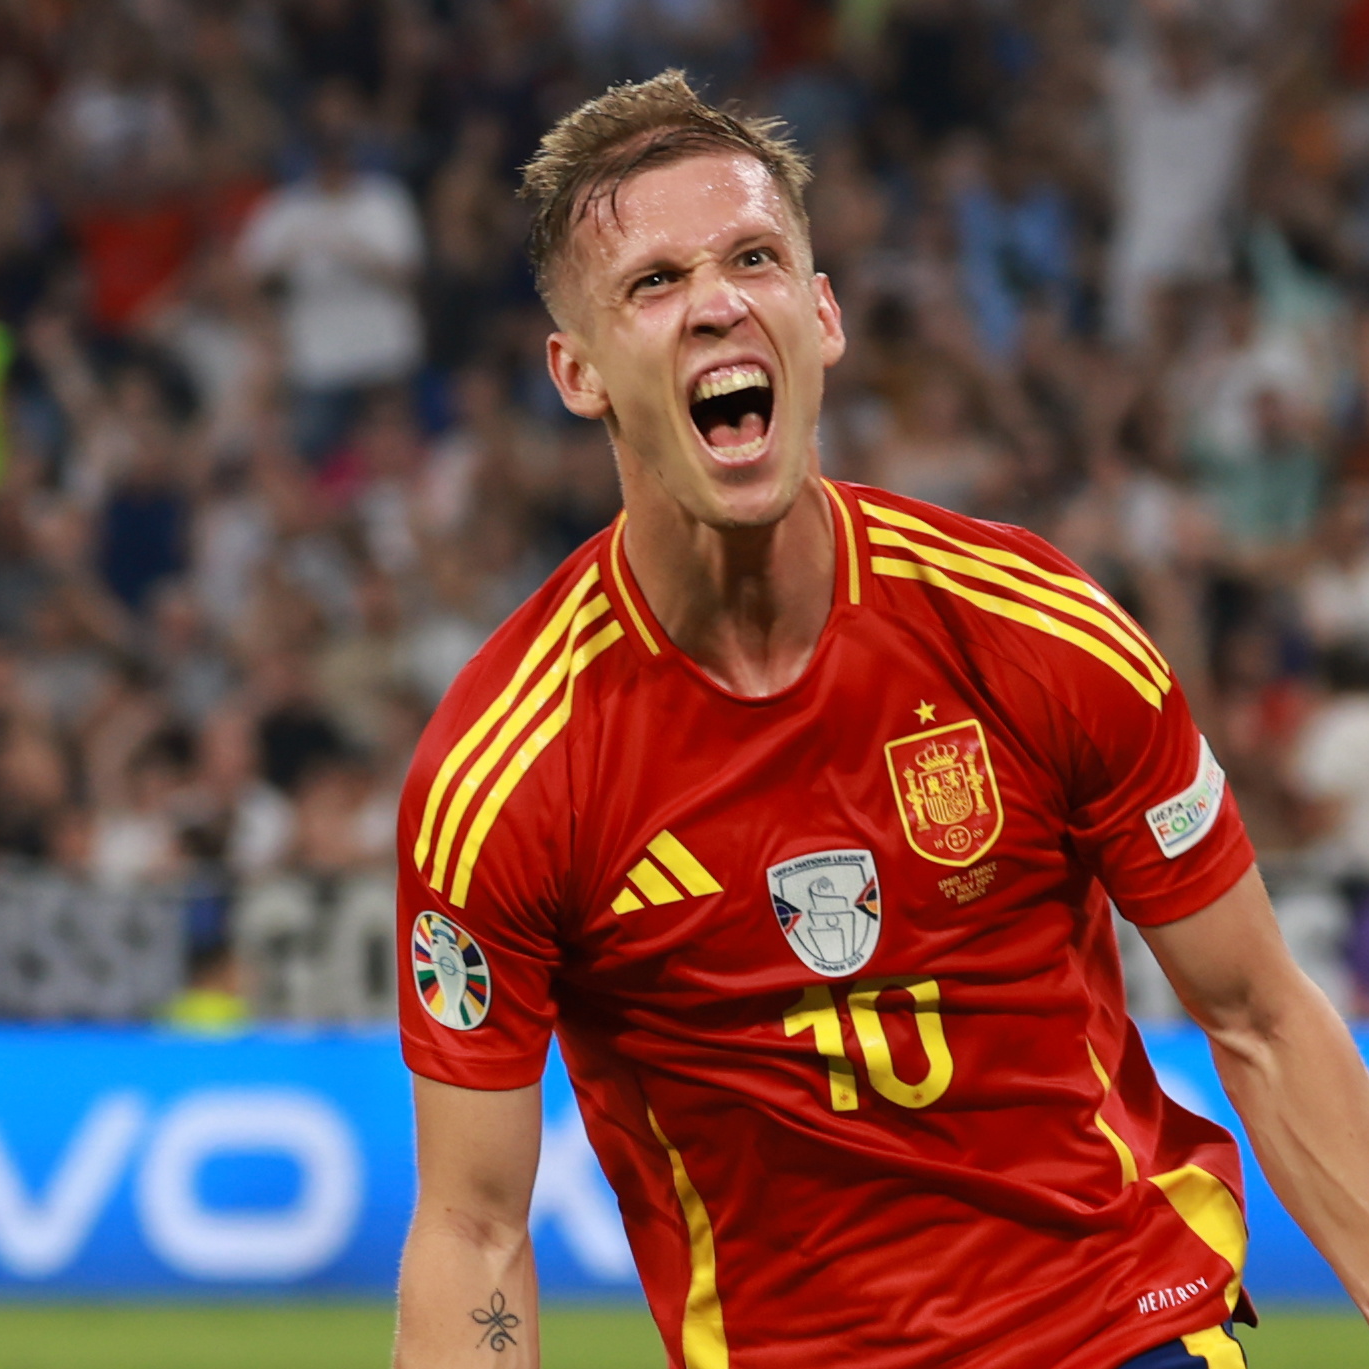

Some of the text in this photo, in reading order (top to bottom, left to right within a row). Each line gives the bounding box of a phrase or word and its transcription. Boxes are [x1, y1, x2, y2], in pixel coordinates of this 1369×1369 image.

[794, 855, 832, 869] NATIONS
[834, 854, 867, 864] LEAGUE
[813, 960, 846, 972] WINNER
[783, 975, 953, 1111] 10
[1137, 1276, 1209, 1315] HEAT.RDY
